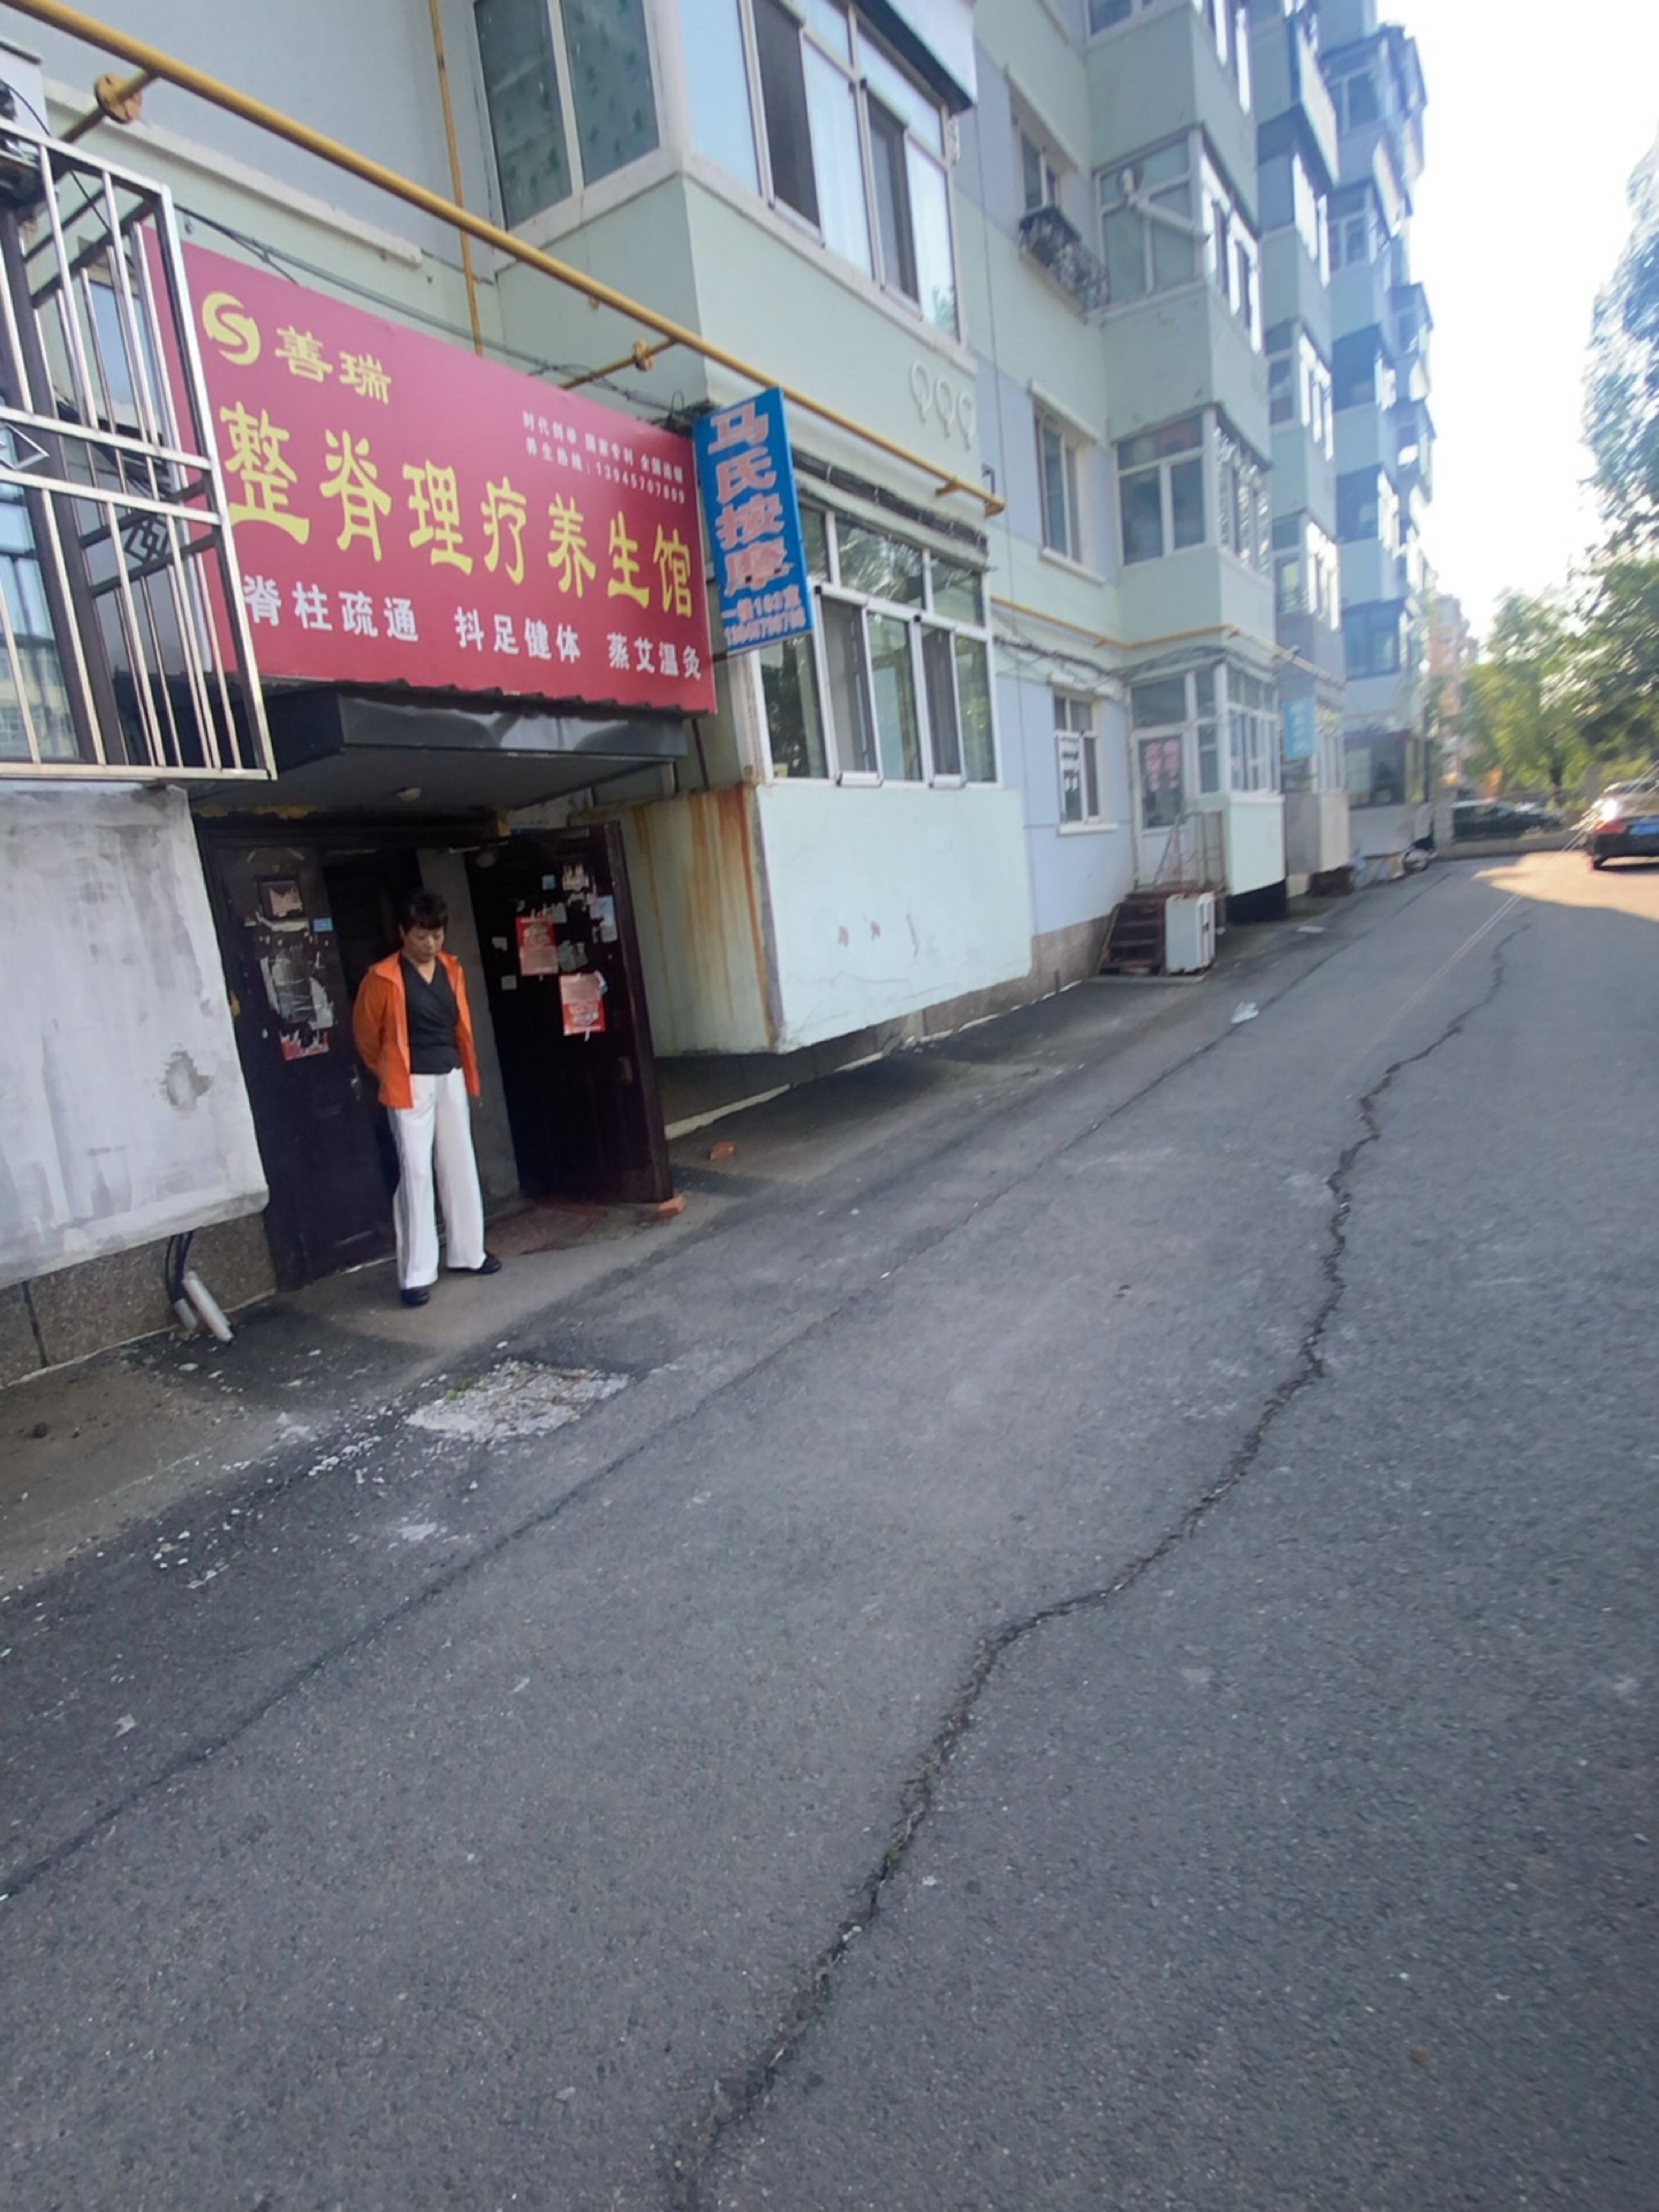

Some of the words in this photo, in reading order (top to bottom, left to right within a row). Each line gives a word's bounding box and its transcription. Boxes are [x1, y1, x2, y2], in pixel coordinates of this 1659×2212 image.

[275, 325, 392, 405] 善瑞
[220, 400, 693, 618] 整脊理疗养生馆
[707, 401, 794, 597] 马氏按摩
[243, 574, 419, 642] 脊柱疏通
[455, 606, 581, 664] 抖足健体
[607, 631, 703, 681] 蒸艾温灸
